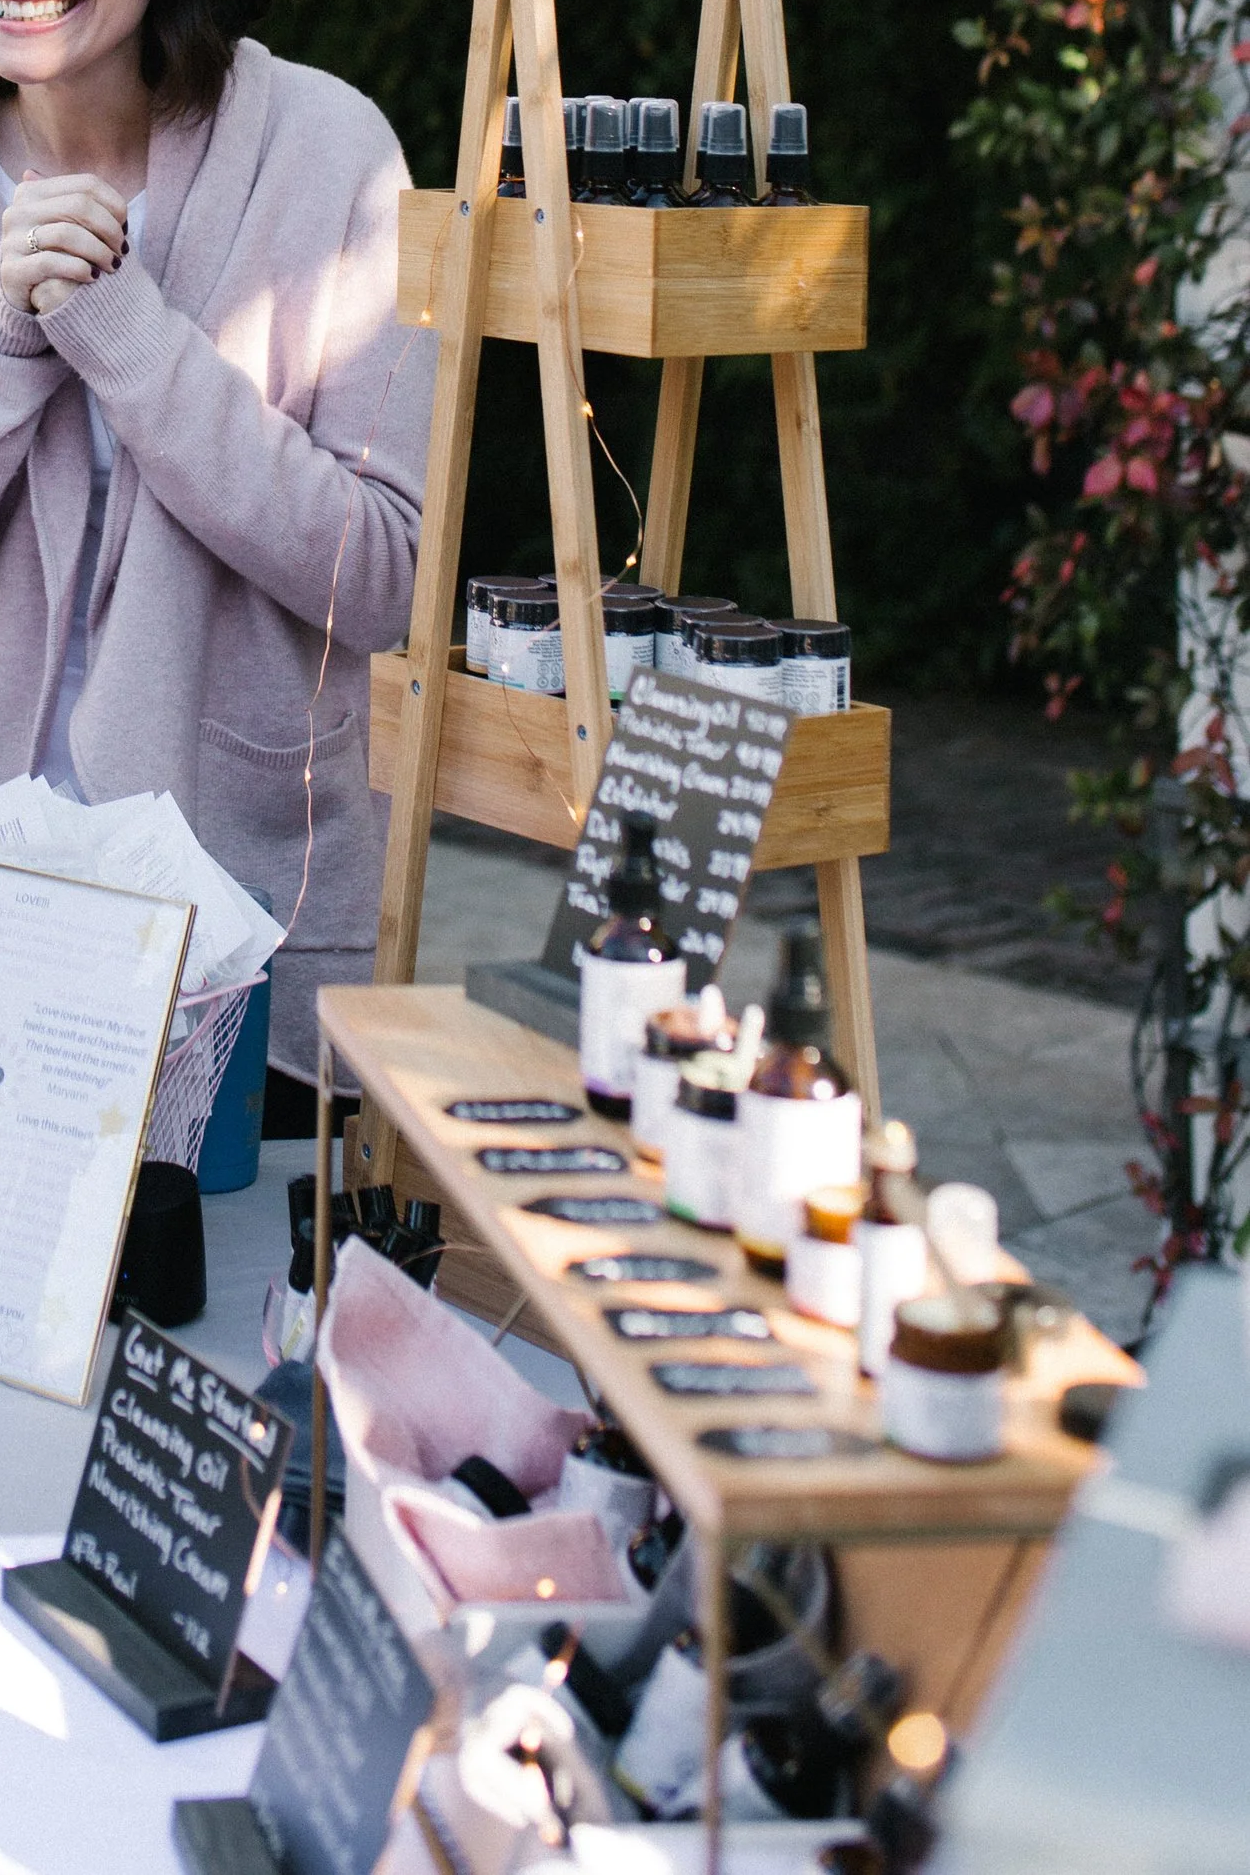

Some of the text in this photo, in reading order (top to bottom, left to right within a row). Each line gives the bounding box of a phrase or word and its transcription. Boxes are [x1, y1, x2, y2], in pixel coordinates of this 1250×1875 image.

[25, 1038, 43, 1052] The
[62, 1049, 81, 1061] and
[82, 1052, 100, 1067] the
[16, 1113, 40, 1127] Love
[41, 1117, 60, 1132] this
[5, 1306, 25, 1322] you
[124, 1323, 165, 1377] Get
[168, 1357, 196, 1401] Me
[195, 1450, 230, 1493] Oil
